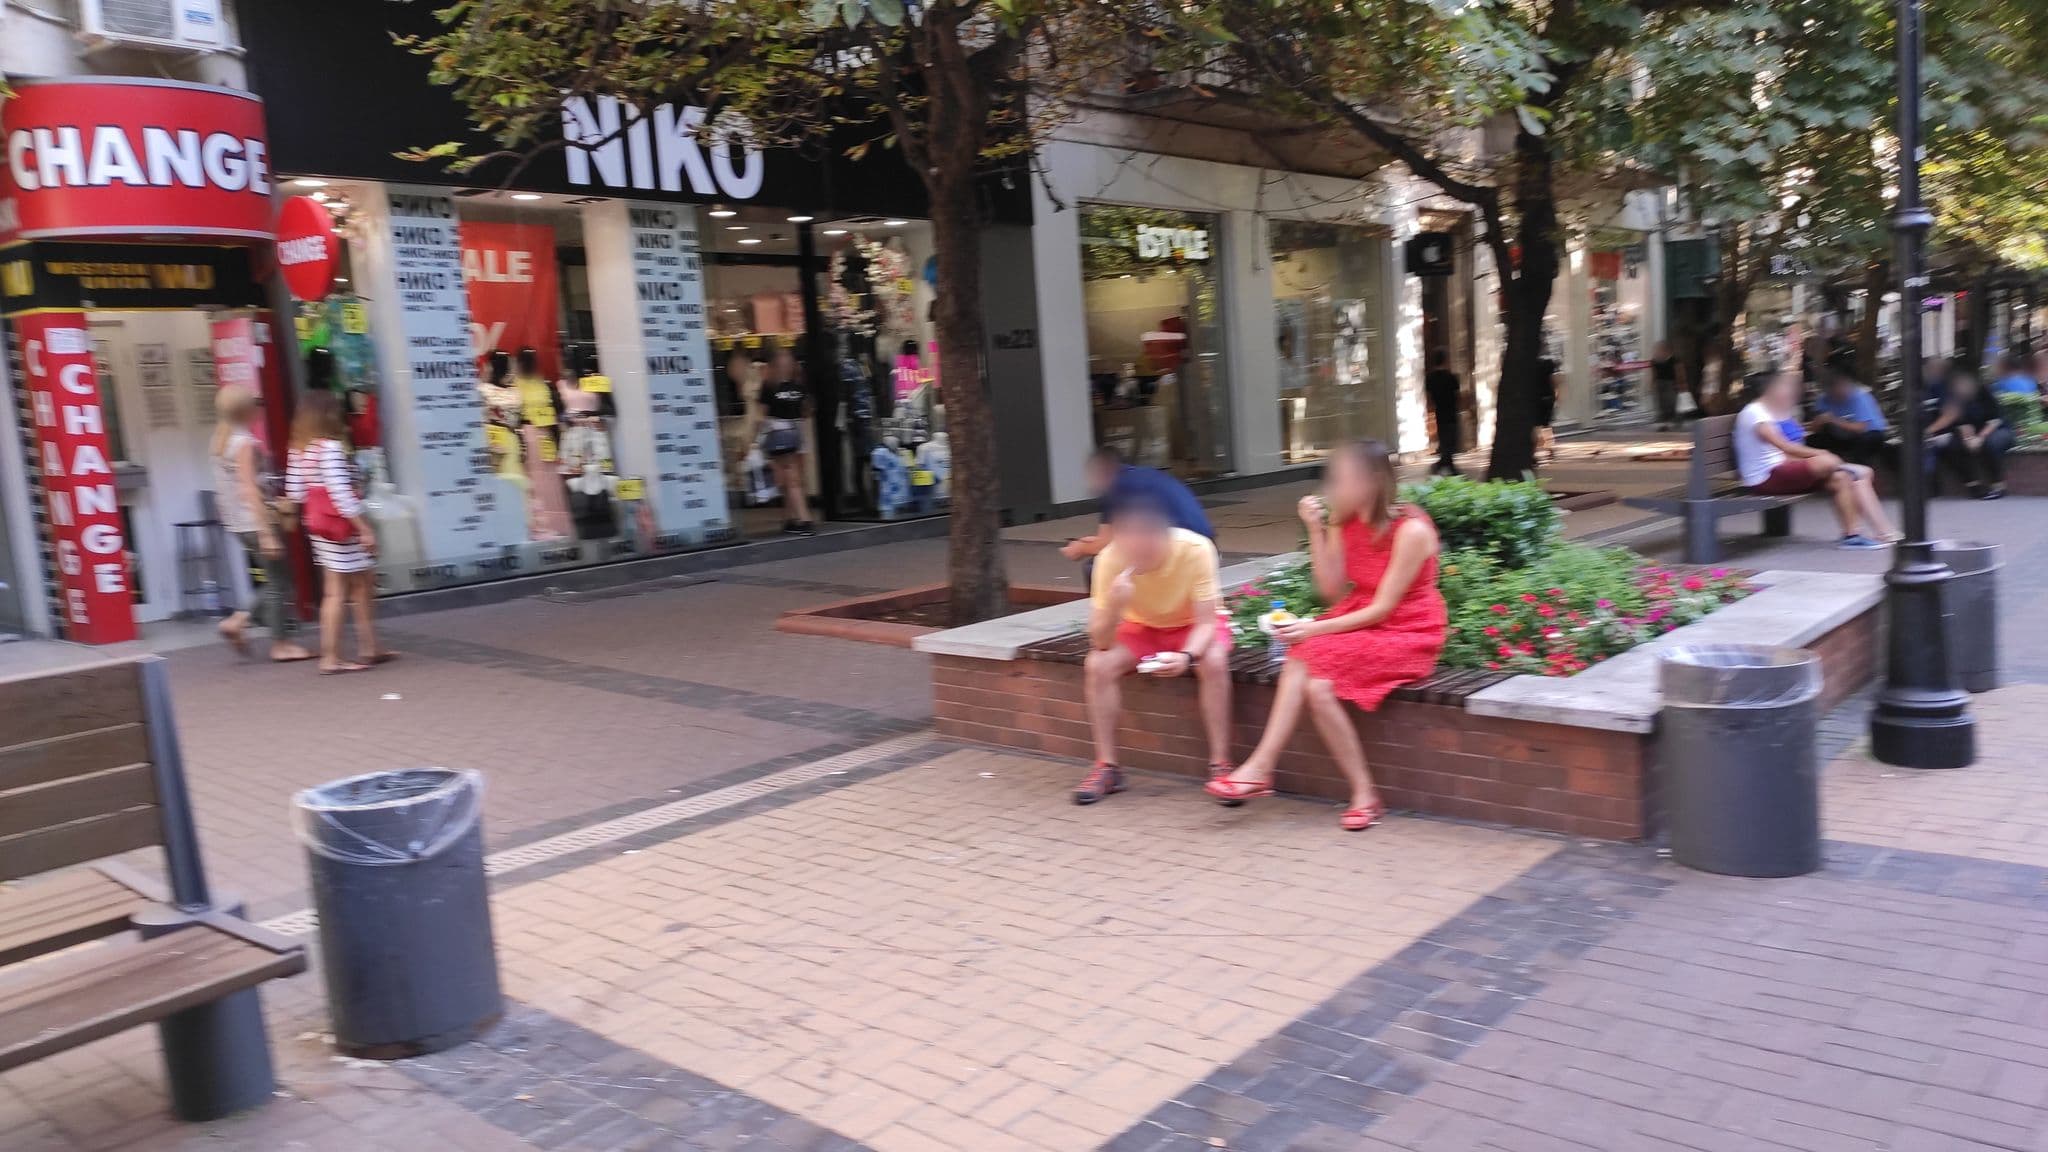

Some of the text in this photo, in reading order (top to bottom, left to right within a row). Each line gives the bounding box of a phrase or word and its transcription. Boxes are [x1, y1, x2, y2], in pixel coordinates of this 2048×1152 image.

[8, 125, 271, 195] CHANGE
[562, 95, 764, 200] NIKO
[277, 235, 328, 266] CHANGE
[461, 248, 534, 283] ALE
[58, 363, 127, 594] CHANGE
